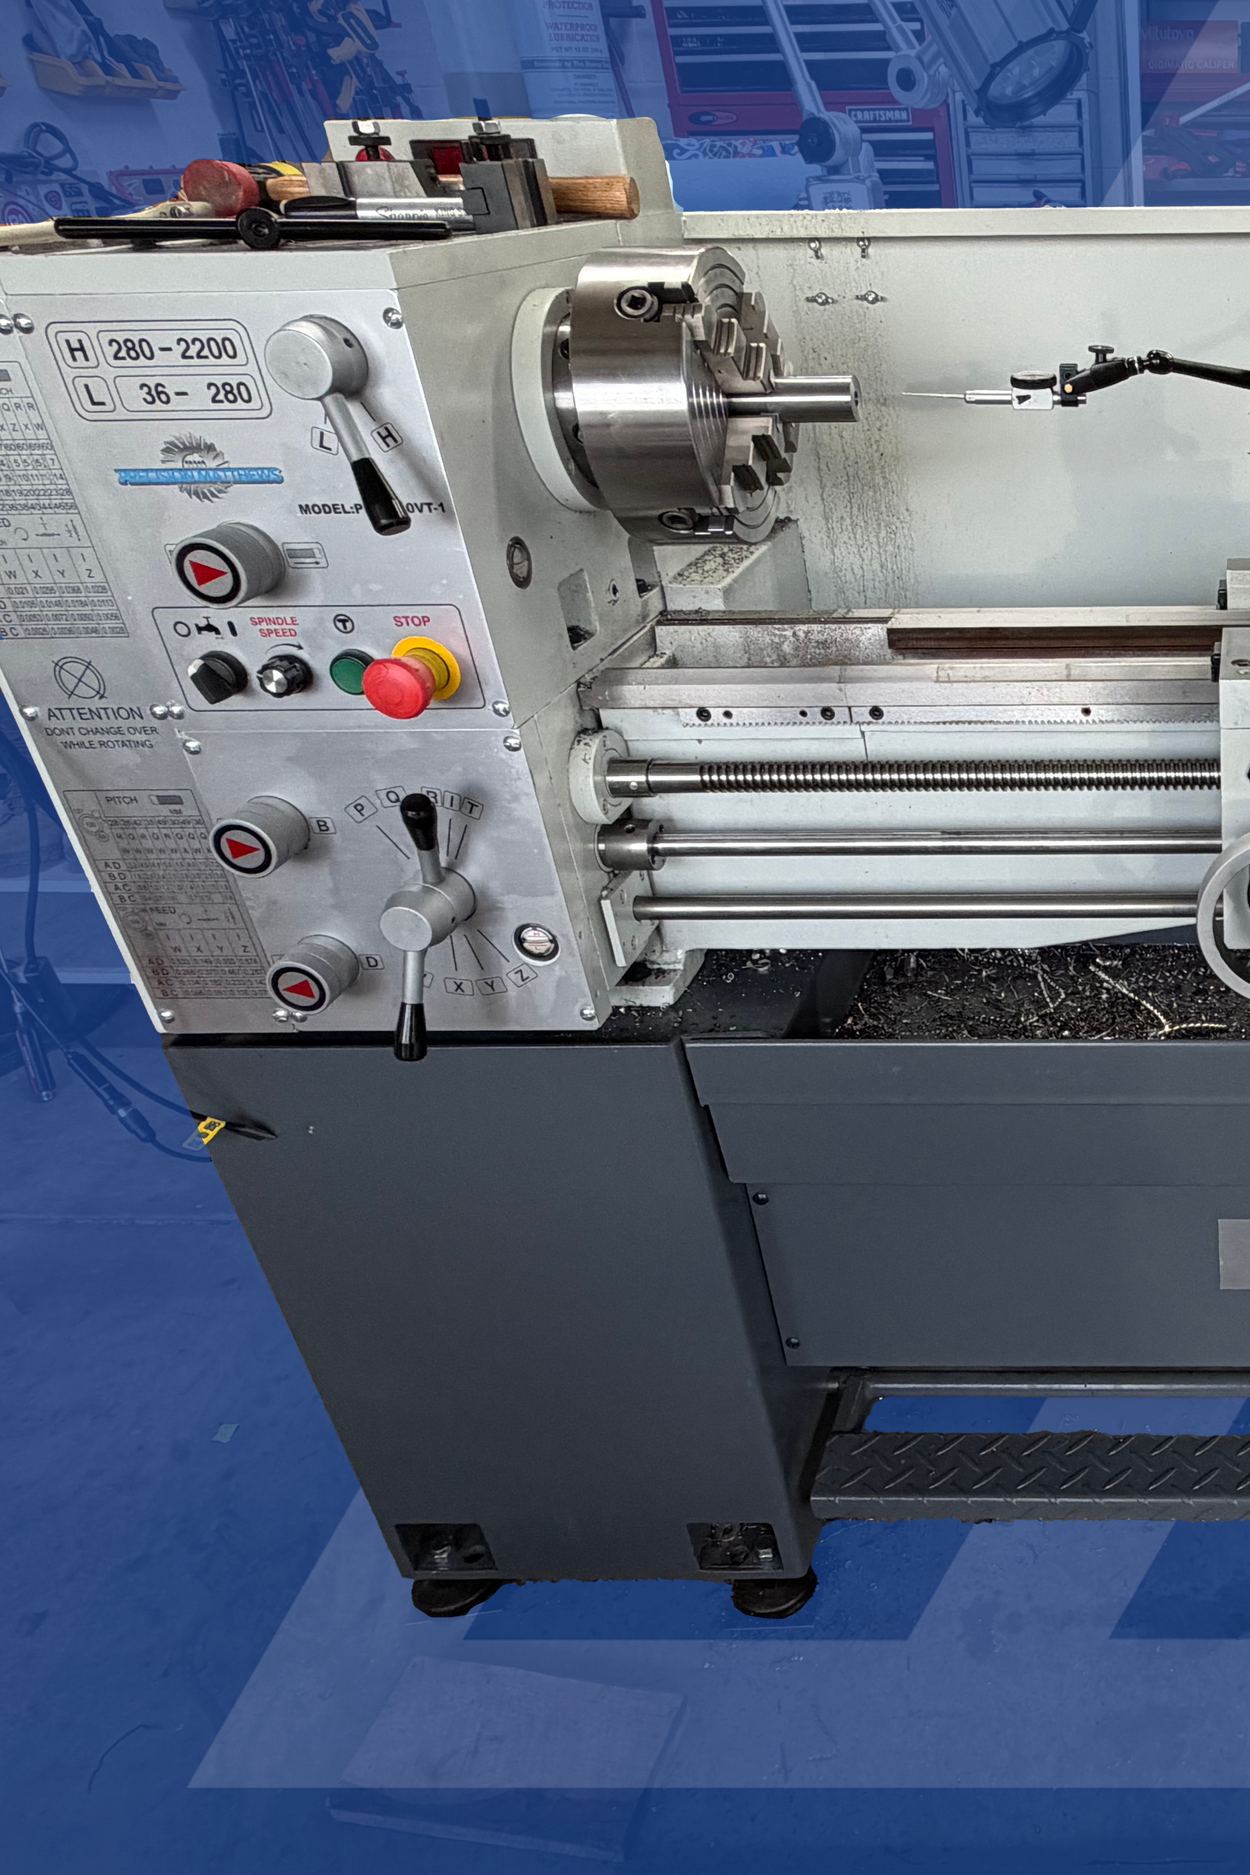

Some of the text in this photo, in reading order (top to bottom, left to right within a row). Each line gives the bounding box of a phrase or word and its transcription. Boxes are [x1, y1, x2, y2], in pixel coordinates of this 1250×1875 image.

[546, 22, 598, 32] WATERPROOF
[1148, 60, 1235, 69] DIGIMATIC CALIPER
[850, 110, 907, 121] CRAFTSMAN
[65, 339, 89, 362] H
[84, 383, 106, 406] L
[206, 381, 253, 404] 280
[380, 426, 399, 447] H
[320, 436, 332, 451] L
[5, 568, 95, 579] W X Y Z
[249, 616, 299, 627] SPINDLE
[393, 615, 431, 628] STOP
[259, 628, 297, 638] SPEED
[47, 706, 144, 721] ATTENTION
[45, 726, 159, 736] DONT CHANGE OVER
[61, 739, 154, 749] WHILE ROTATING
[105, 796, 138, 805] PITCH
[385, 790, 401, 804] Q
[353, 802, 367, 817] P
[467, 801, 479, 814] T
[317, 820, 330, 832] B
[366, 956, 378, 967] D
[515, 968, 529, 983] Z
[453, 981, 464, 992] X
[485, 980, 496, 991] Y
